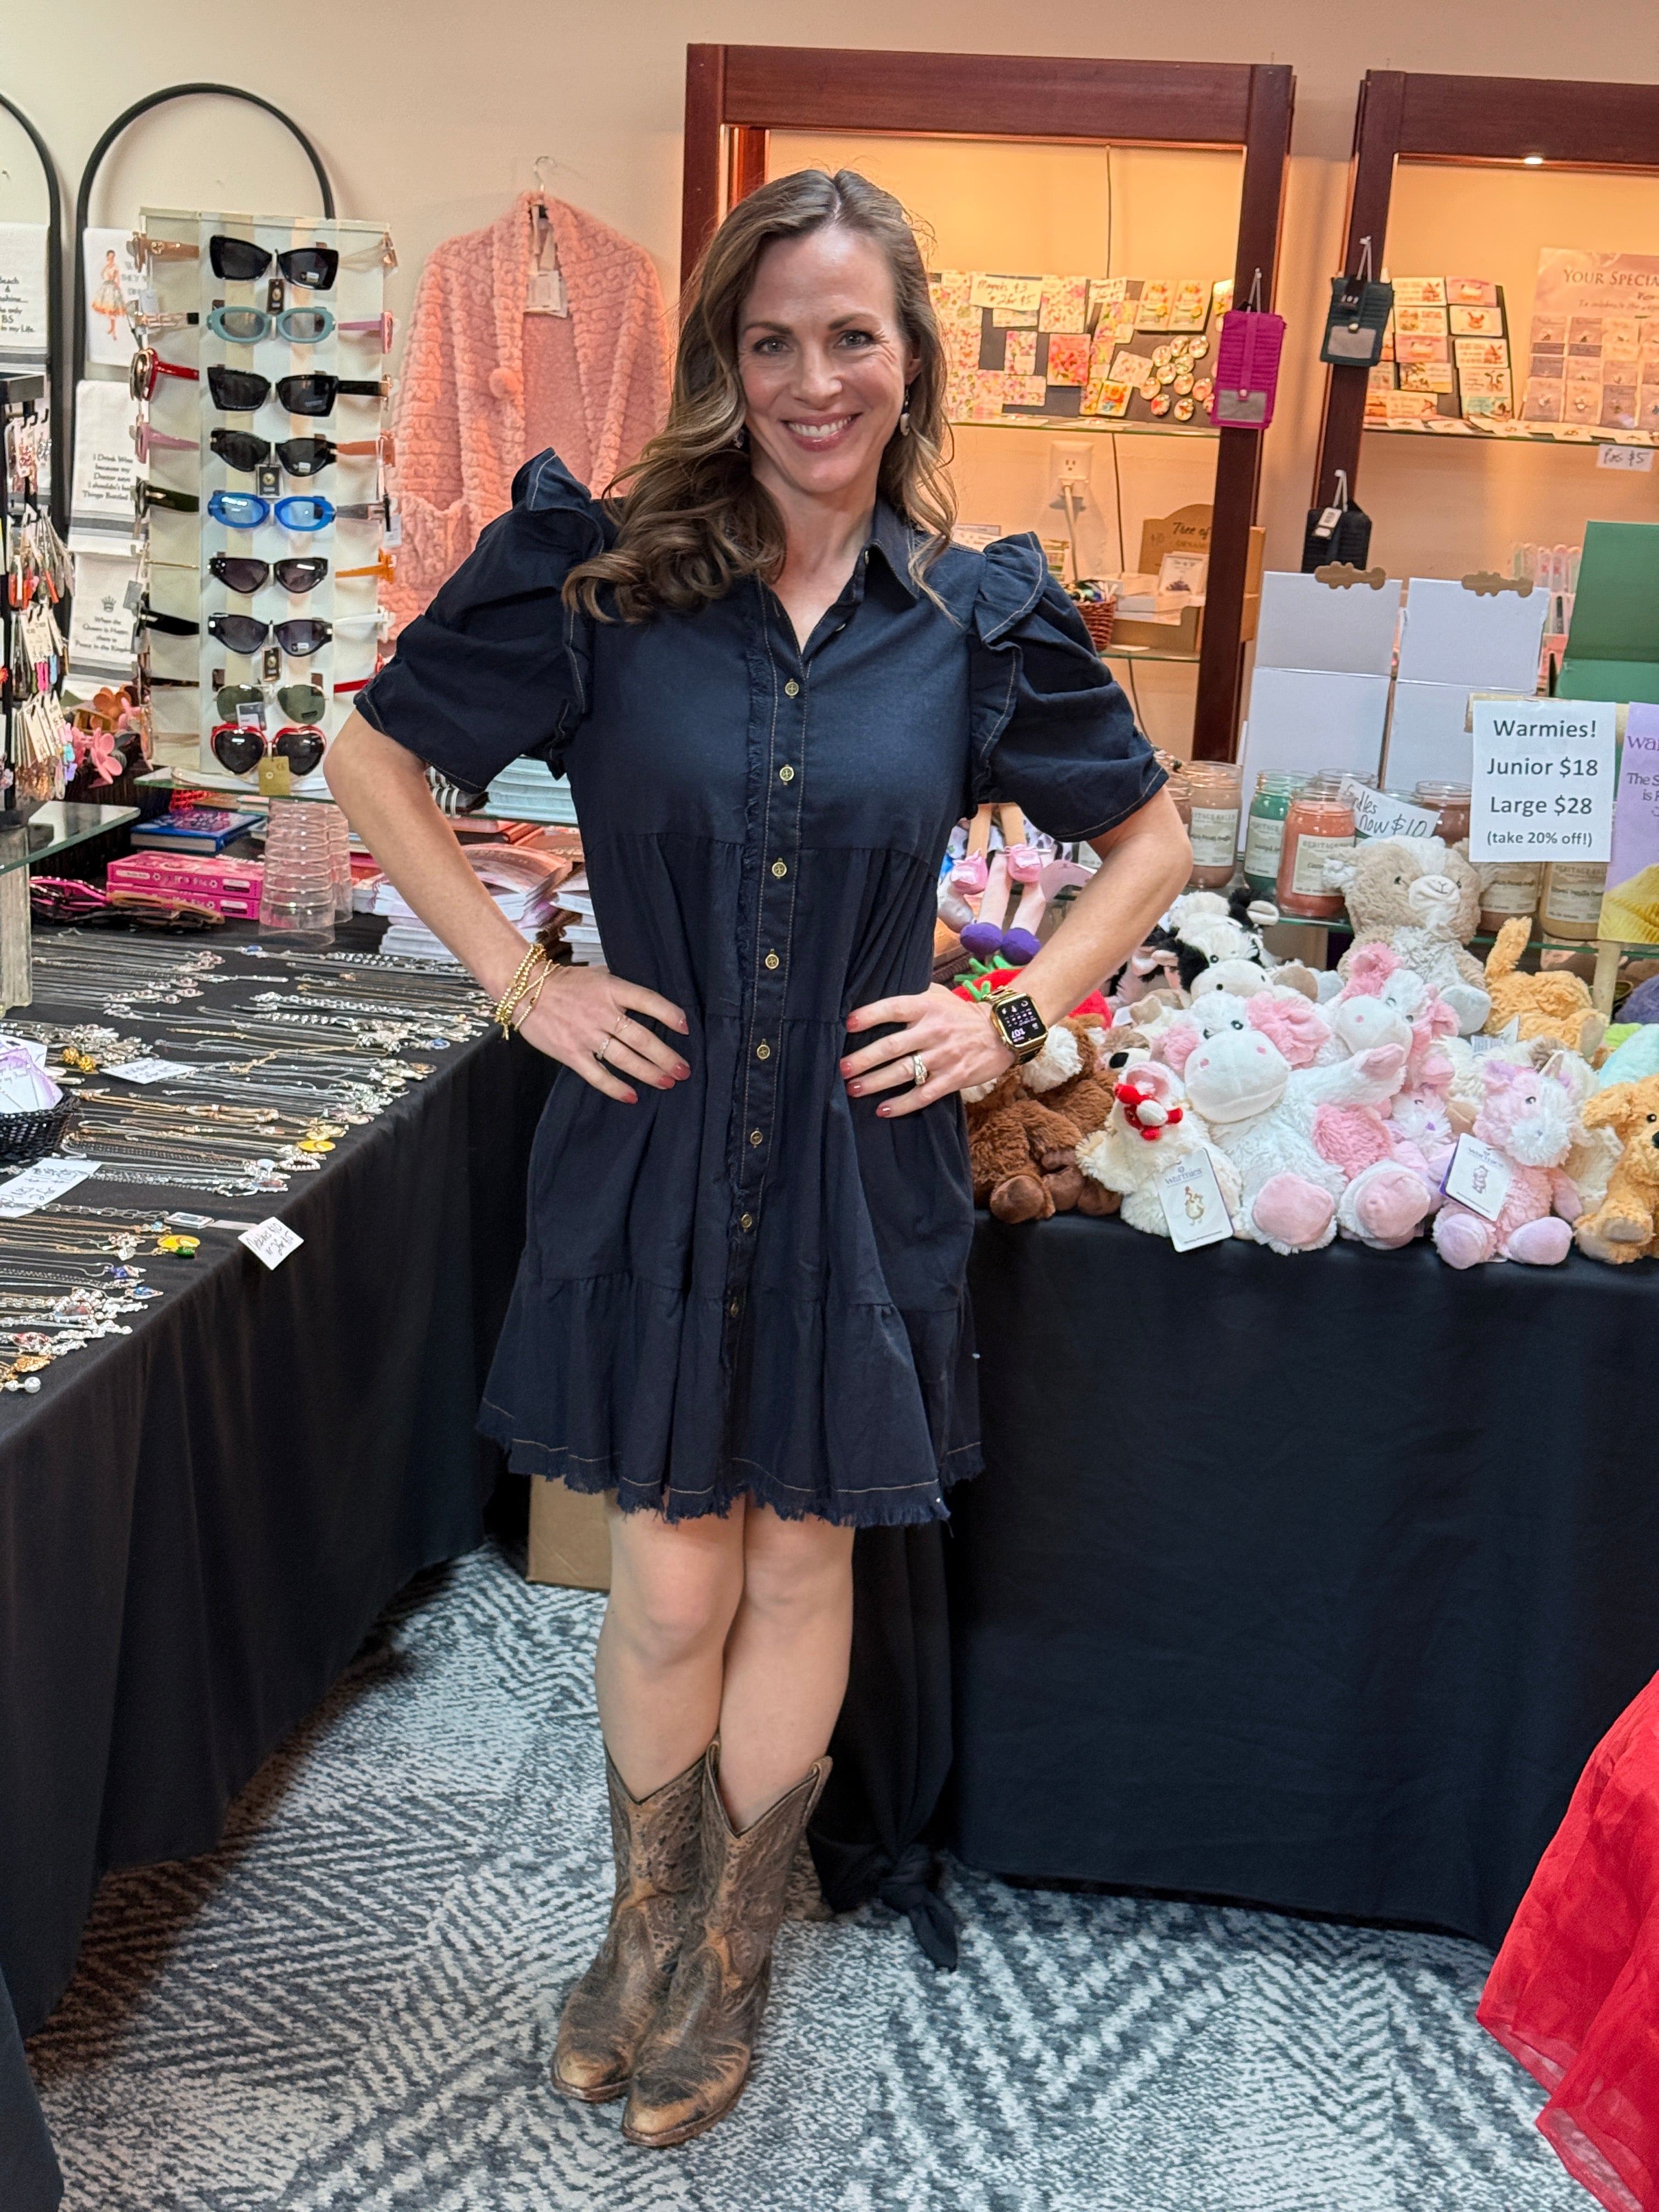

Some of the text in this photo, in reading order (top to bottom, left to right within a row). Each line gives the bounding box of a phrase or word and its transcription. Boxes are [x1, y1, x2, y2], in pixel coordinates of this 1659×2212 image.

[1564, 269, 1604, 284] YOUR
[2, 314, 14, 324] BS
[1628, 450, 1650, 467] $5
[1173, 522, 1196, 535] Tree
[1493, 720, 1597, 738] Warmies!
[1487, 757, 1598, 778] Junior $18
[1627, 772, 1650, 785] The
[1643, 788, 1652, 801] is
[1491, 794, 1593, 816] Large $28
[1391, 813, 1427, 838] $10
[1487, 831, 1593, 848] (take 20% off!)
